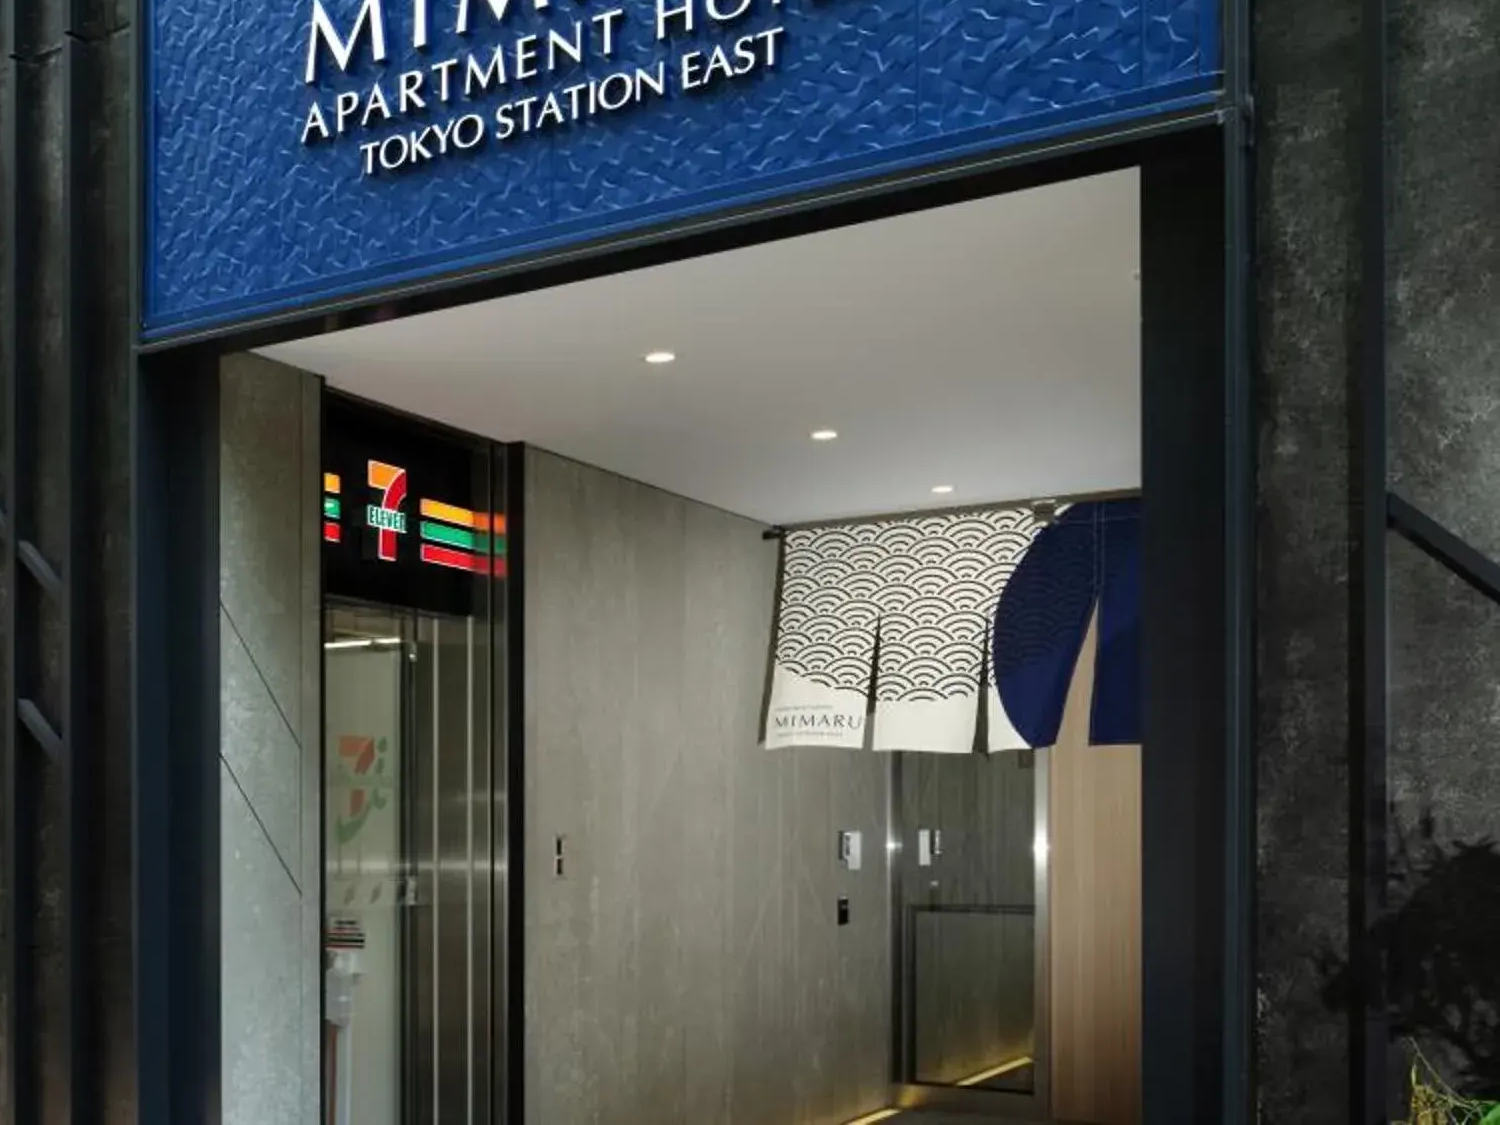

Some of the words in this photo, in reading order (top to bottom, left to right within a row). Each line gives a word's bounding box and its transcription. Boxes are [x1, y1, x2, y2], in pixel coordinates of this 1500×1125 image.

[301, 8, 624, 143] APARTMENT
[360, 113, 484, 175] TOKYO
[495, 60, 666, 140] STATION
[681, 26, 785, 90] EAST
[774, 714, 863, 730] MIMARU
